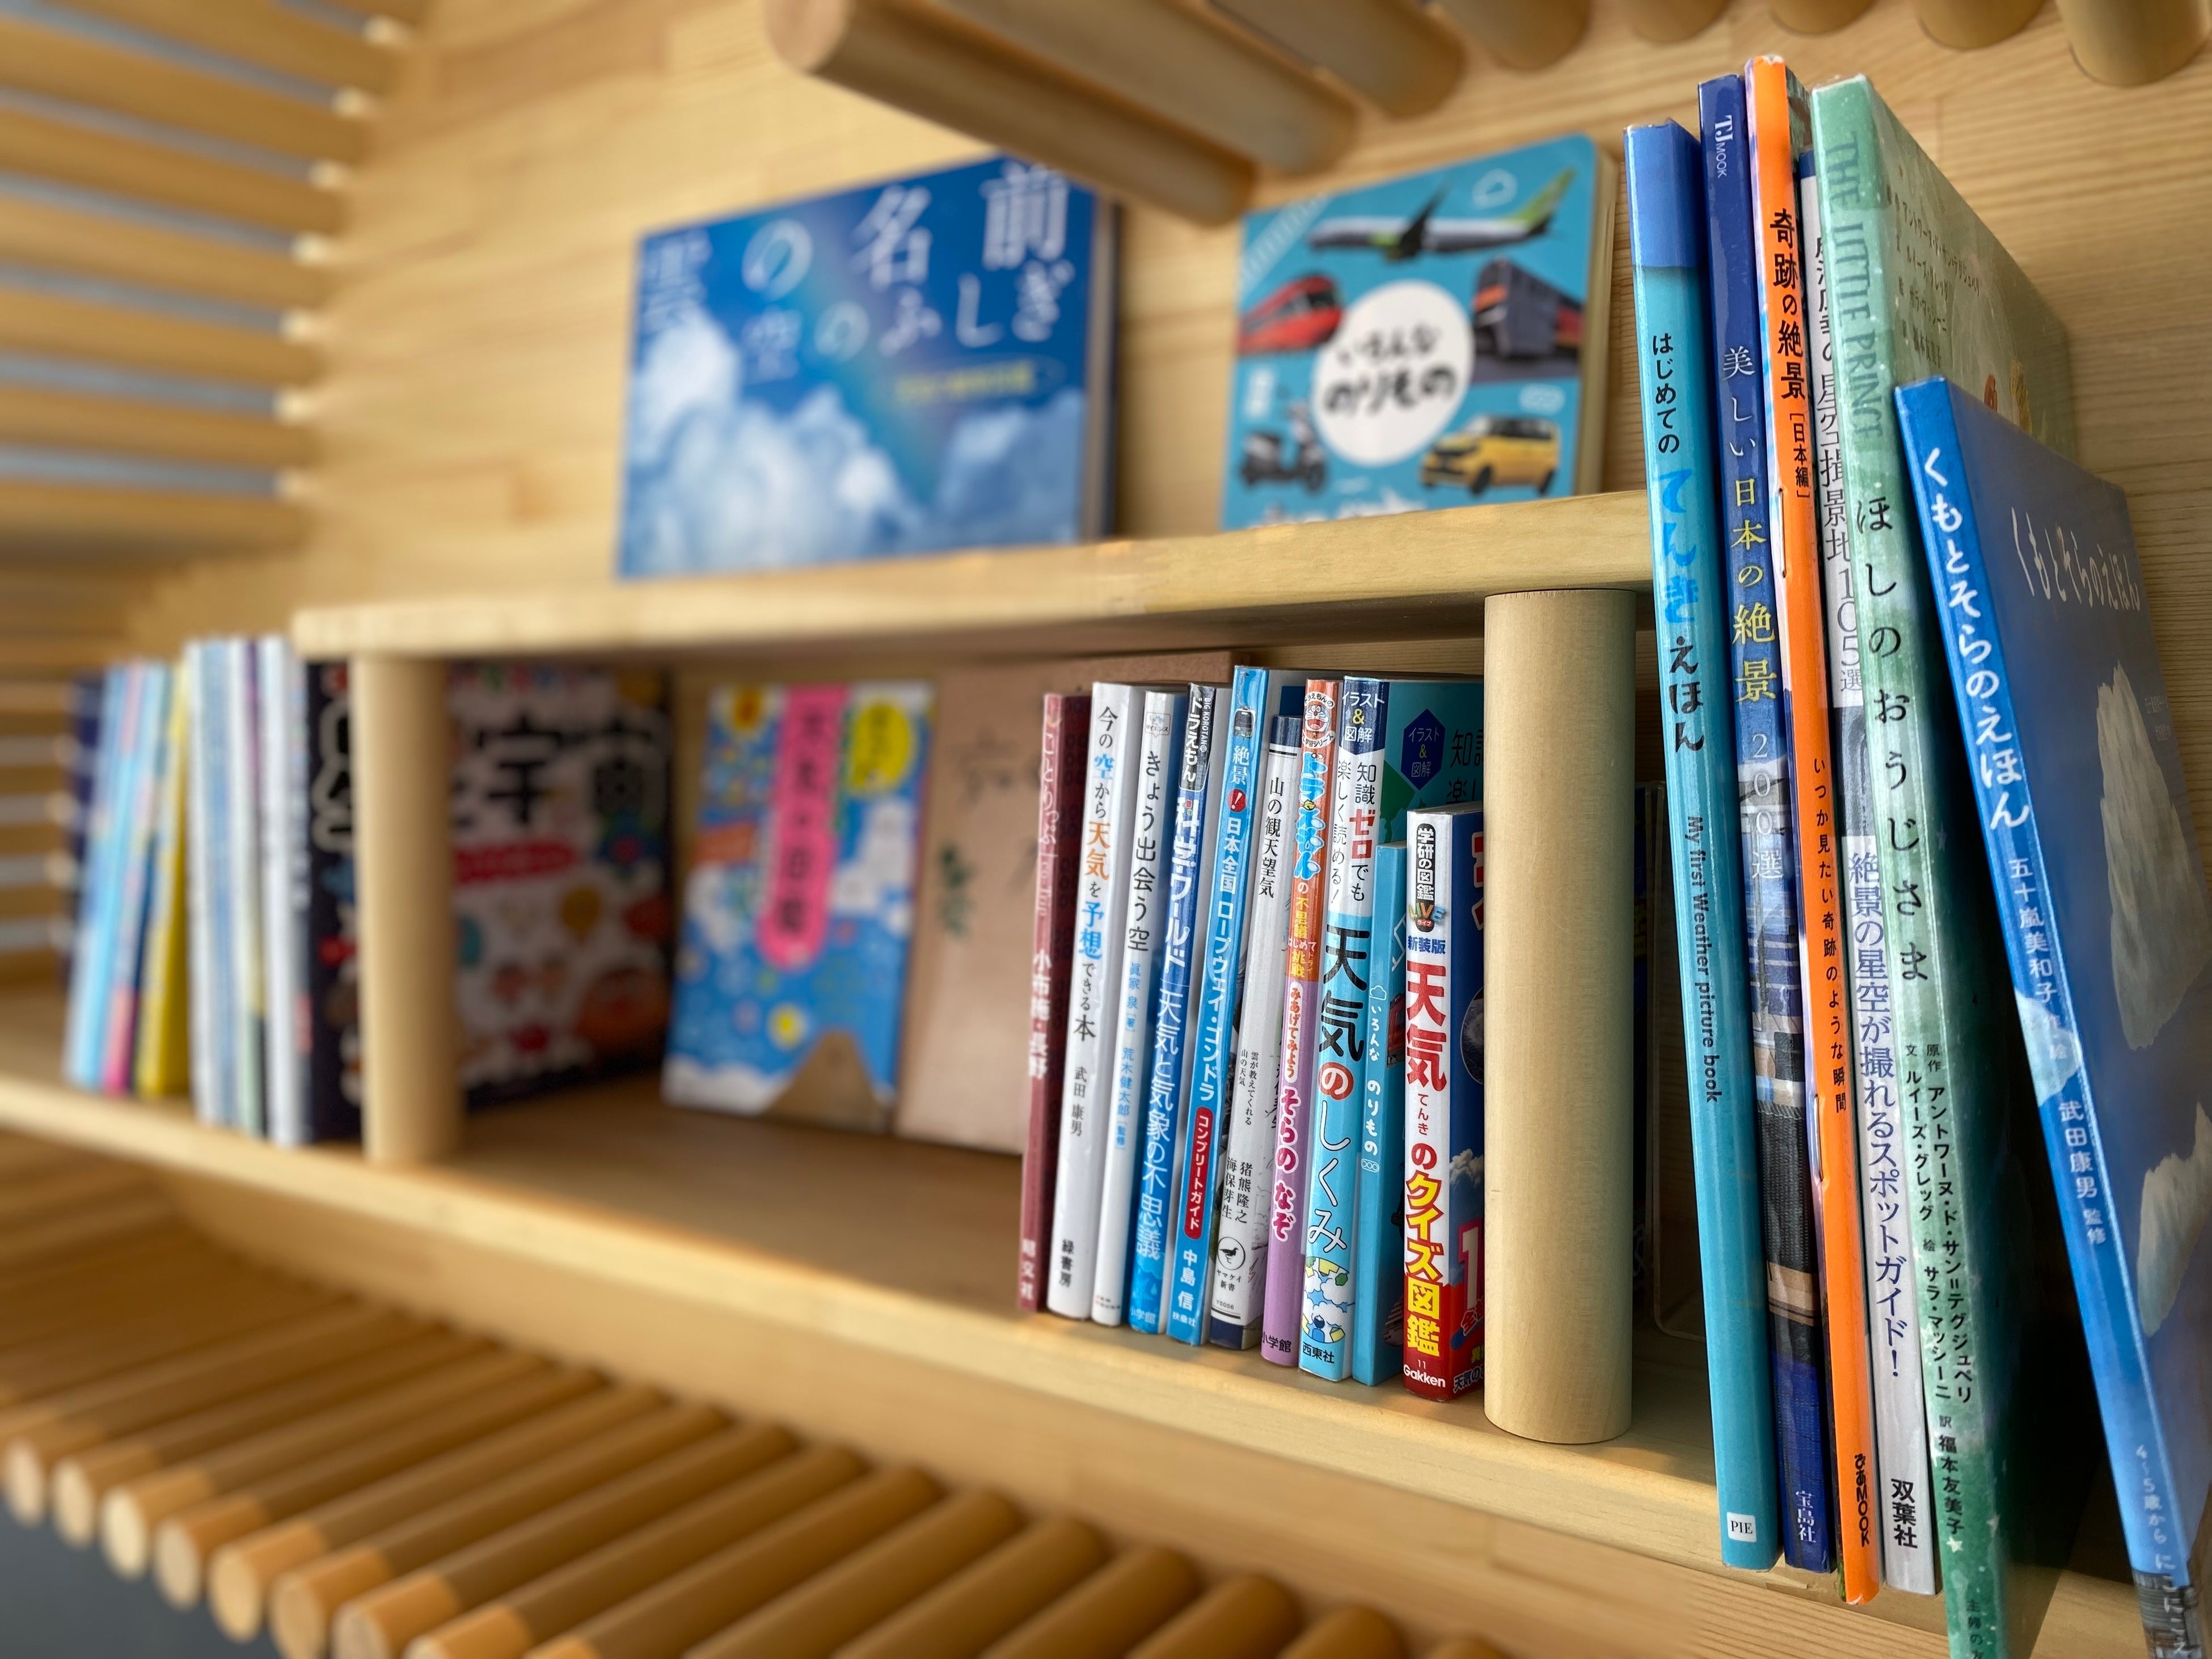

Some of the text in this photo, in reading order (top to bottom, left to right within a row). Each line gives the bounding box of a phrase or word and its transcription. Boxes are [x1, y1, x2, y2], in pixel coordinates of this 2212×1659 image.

[1826, 130, 1861, 214] THE
[1770, 208, 1806, 400] 奇跡の絶景
[1323, 365, 1458, 417] のりもの
[1652, 332, 1680, 454] はじめての
[1843, 330, 1884, 438] PRINCE
[1924, 448, 2030, 829] くもとそらのえほん
[1182, 696, 1202, 783] ドラえもん
[1342, 691, 1385, 708] イラスト
[1344, 727, 1373, 743] 図解
[1408, 726, 1440, 743] イラスト
[1857, 497, 1928, 981] ほしのおうじさま
[1411, 761, 1431, 778] 図解
[1073, 706, 1118, 1042] 今の空から天気を予想できる本
[1128, 750, 1162, 952] きょう出会う空
[1258, 776, 1285, 898] 山の観天望気
[1349, 762, 1377, 901] 知識ゼロでも
[1417, 828, 1434, 901] 学研の図鑑
[1407, 935, 1446, 955] 新装版
[1685, 816, 1720, 1103] My first Weather picture book
[1814, 758, 1847, 1113] いつか見たい奇跡のような瞬間
[2008, 857, 2058, 1004] 五十嵐美和子
[1239, 1049, 1248, 1087] 山の天気
[1286, 987, 1302, 1078] みあげてみよう
[1407, 960, 1447, 1092] 天気
[1136, 987, 1184, 1261] 天気と気象の不思議
[1245, 1051, 1259, 1126] 雲が教えてくれる
[1307, 924, 1371, 1253] 天気のしくみ
[1365, 1005, 1382, 1156] いろんな のりもの
[1417, 1092, 1429, 1135] てんき
[1848, 853, 1907, 1377] 絶景の星空が撮れるスポットガイド!
[1189, 1115, 1209, 1231] コンプリートガイド
[1221, 1156, 1238, 1220] 海保芽生
[1234, 1162, 1252, 1224] 猪熊隆之
[1272, 1088, 1301, 1240] そらの なぞ
[2058, 1100, 2098, 1199] 武田康男
[1058, 1239, 1074, 1288] 緑書房
[1216, 1269, 1243, 1282] ヤマケイ
[1220, 1280, 1236, 1293] 新書
[1405, 1170, 1444, 1357] クイズ図鑑
[1905, 1044, 1918, 1057] 文
[1924, 1266, 1951, 1400] サラ・マッシーニ
[1939, 1434, 1964, 1535] 福本友美子
[1262, 1331, 1292, 1353] 小学館
[1302, 1342, 1335, 1365] 西東社
[1403, 1363, 1446, 1388] Gakken
[1730, 1520, 1753, 1534] PIE
[1795, 1489, 1817, 1544] 宝島社
[1890, 1478, 1919, 1549] 双葉社
